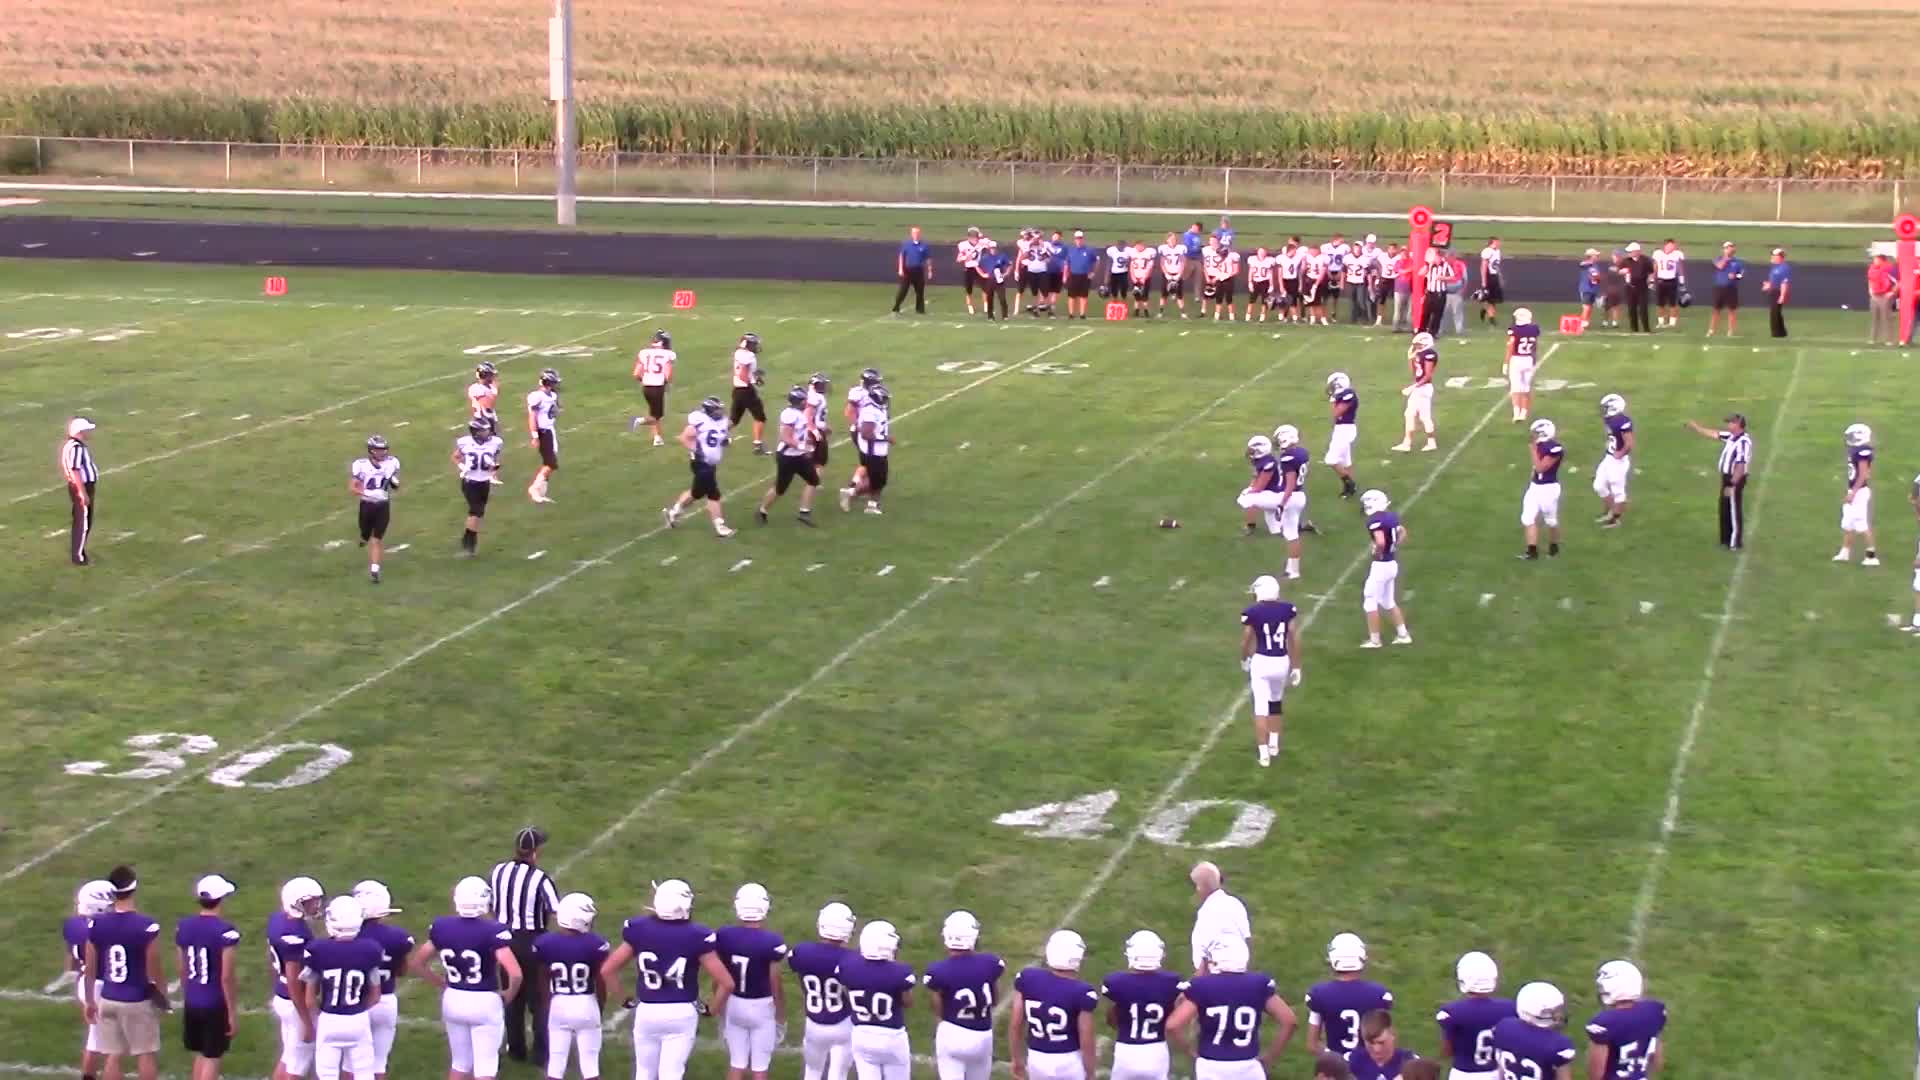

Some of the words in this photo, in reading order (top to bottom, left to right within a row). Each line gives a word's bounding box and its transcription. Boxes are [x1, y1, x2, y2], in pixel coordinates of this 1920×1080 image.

[1432, 223, 1450, 246] 2
[645, 355, 663, 374] 15
[1263, 622, 1286, 650] 14
[63, 733, 352, 790] 30
[992, 789, 1276, 849] 40
[109, 944, 128, 984] 8
[187, 945, 209, 984] 11
[440, 949, 482, 985] 63
[549, 962, 590, 995] 28
[638, 951, 688, 990] 64
[731, 955, 750, 993] 7
[323, 968, 365, 1007] 70
[803, 974, 844, 1013] 88
[849, 991, 893, 1021] 50
[954, 982, 993, 1020] 21
[1025, 999, 1068, 1042] 52
[1128, 1002, 1165, 1040] 12
[1206, 1005, 1257, 1047] 79
[1340, 1009, 1360, 1049] 3
[1615, 1036, 1658, 1078] 54
